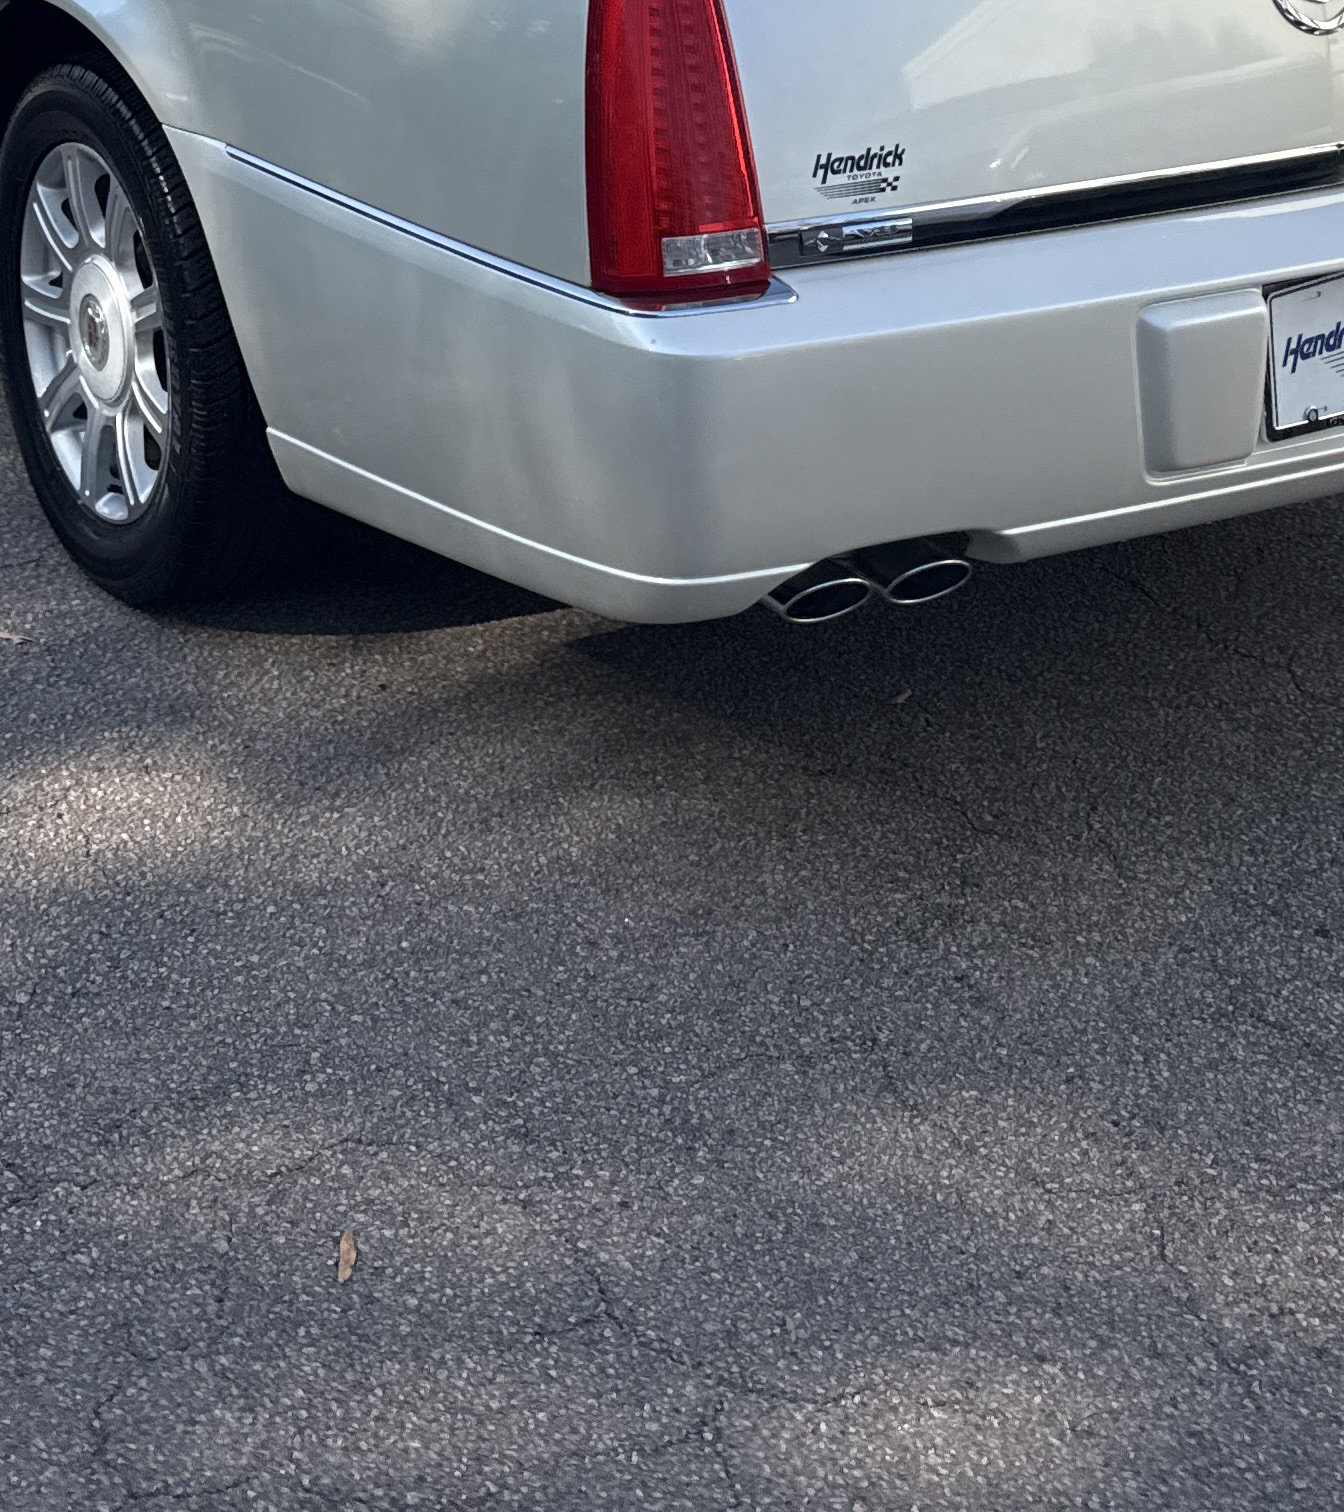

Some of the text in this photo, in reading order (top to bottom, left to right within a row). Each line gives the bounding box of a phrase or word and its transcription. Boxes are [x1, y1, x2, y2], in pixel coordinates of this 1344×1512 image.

[812, 143, 906, 185] Hendrick
[847, 171, 883, 181] TOYOTA
[851, 196, 877, 205] APEX
